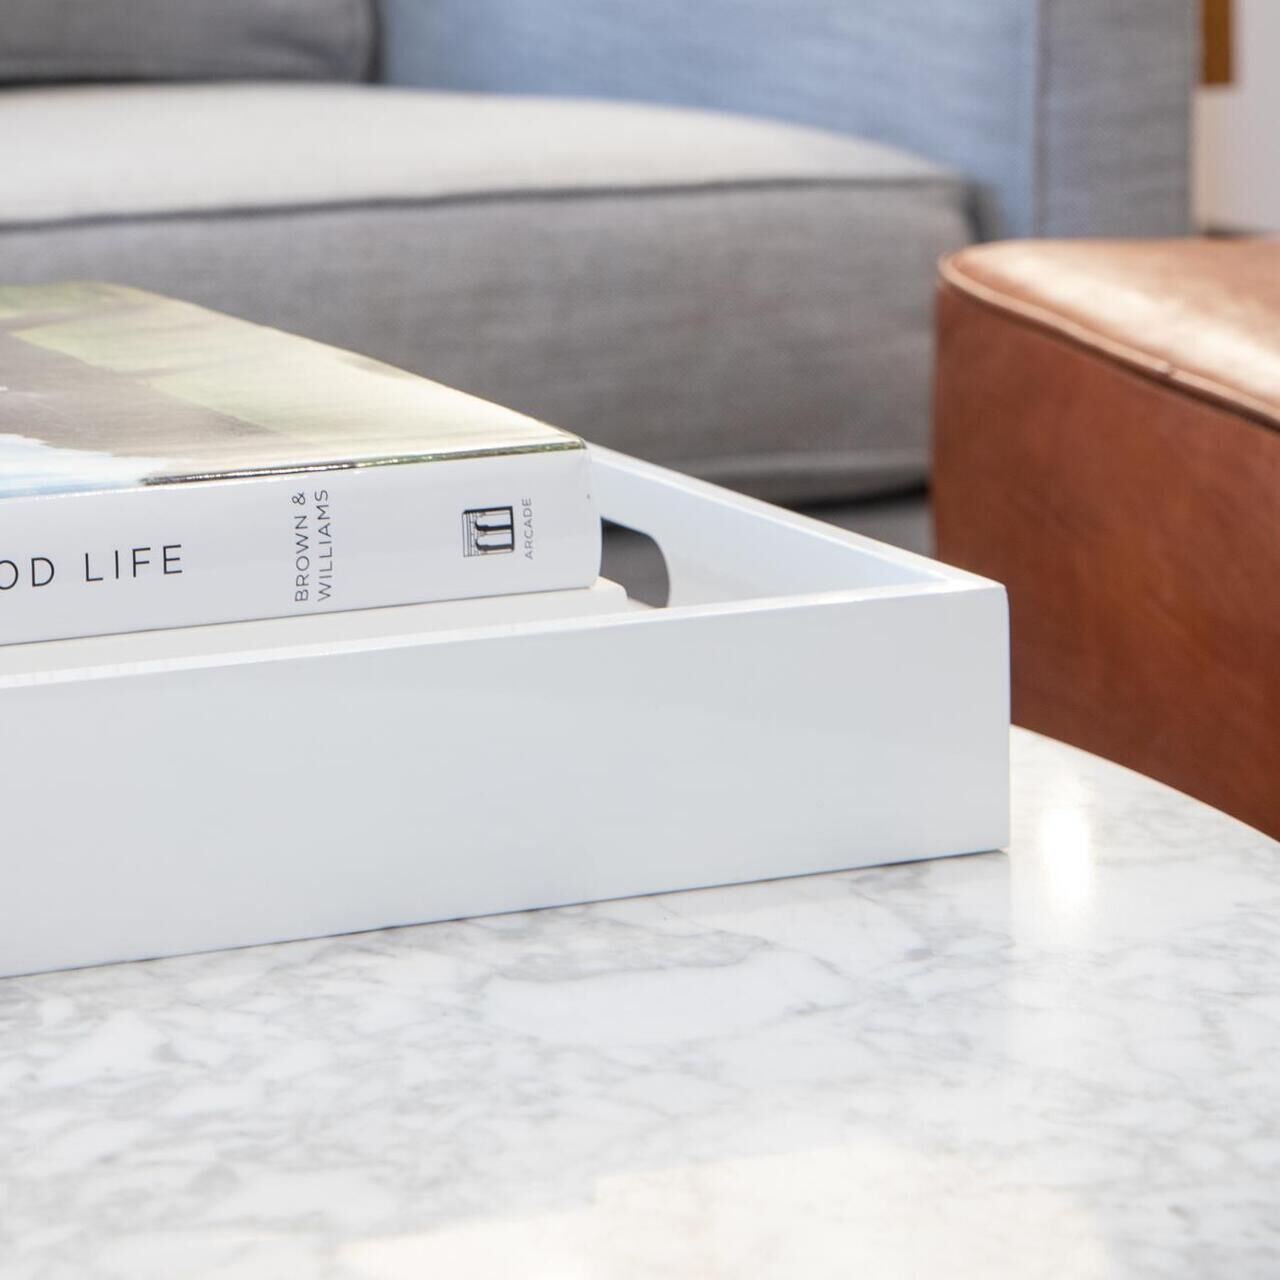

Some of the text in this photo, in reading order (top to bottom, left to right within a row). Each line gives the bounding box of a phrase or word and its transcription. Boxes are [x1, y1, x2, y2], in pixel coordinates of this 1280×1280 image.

[84, 544, 184, 582] LIFE
[291, 491, 311, 602] BROWN &
[314, 489, 333, 602] WILLIAMS
[521, 497, 534, 560] ARCADE
